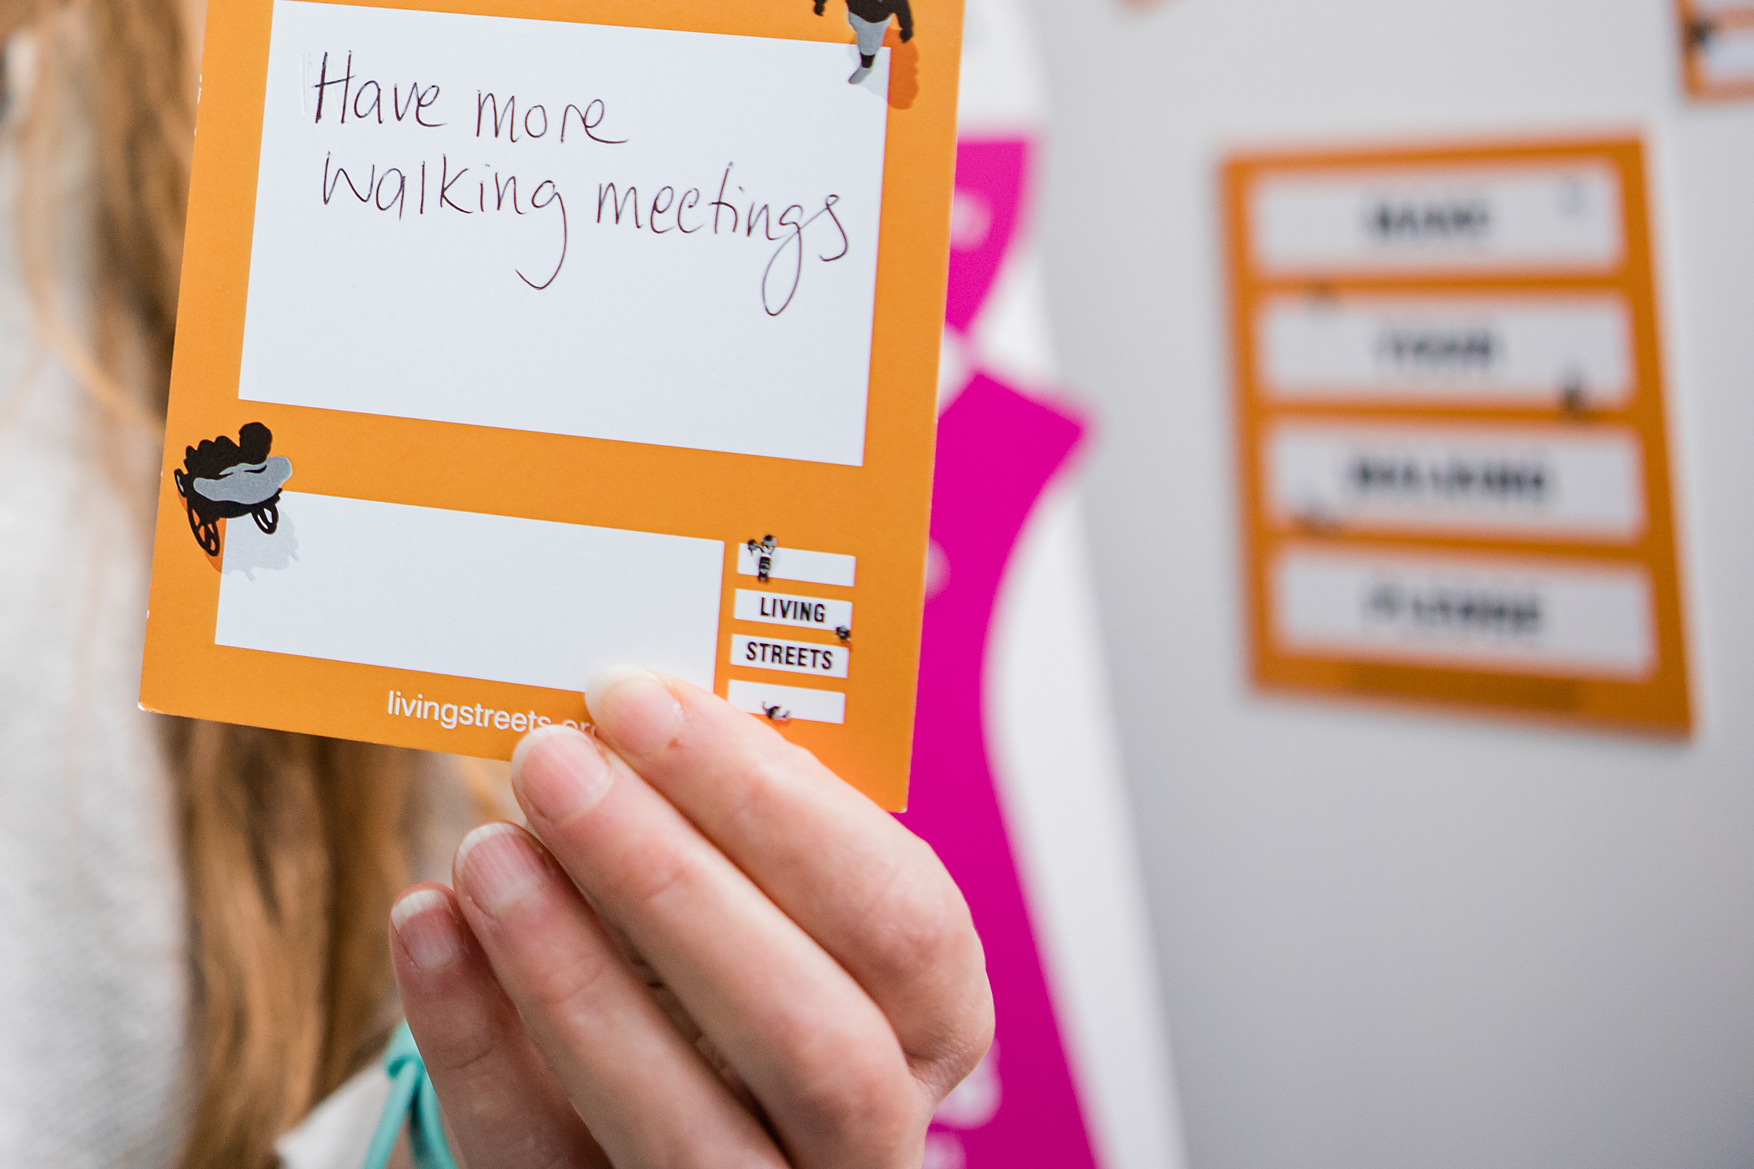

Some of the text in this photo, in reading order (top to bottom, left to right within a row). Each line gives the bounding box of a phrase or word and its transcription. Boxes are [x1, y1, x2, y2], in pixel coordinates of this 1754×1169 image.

[312, 49, 629, 145] Have more
[597, 161, 849, 317] meetings
[759, 596, 826, 624] LIVING
[746, 641, 834, 671] STREETS
